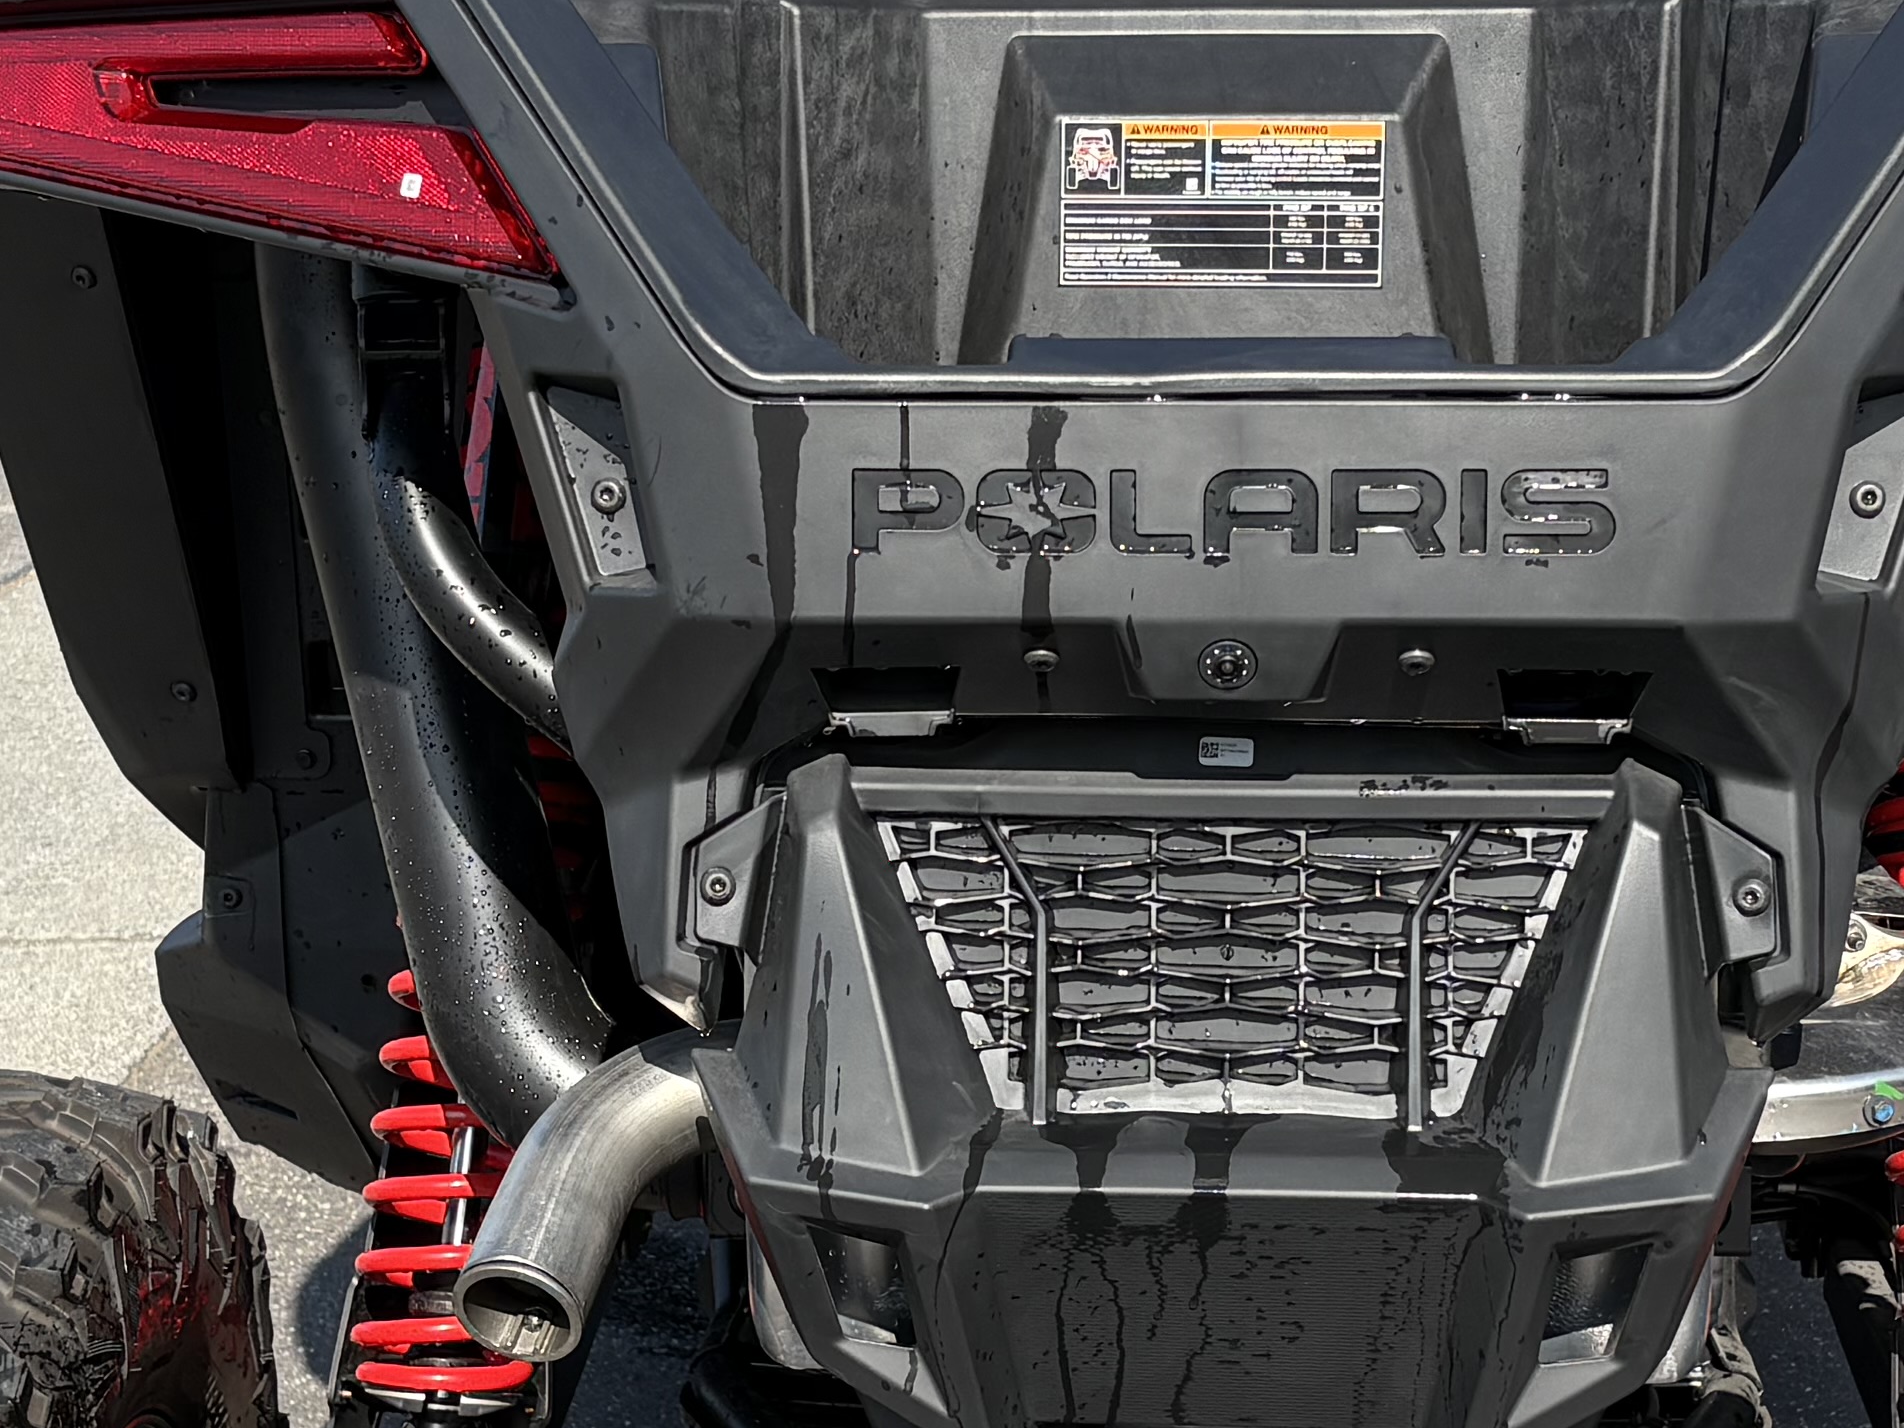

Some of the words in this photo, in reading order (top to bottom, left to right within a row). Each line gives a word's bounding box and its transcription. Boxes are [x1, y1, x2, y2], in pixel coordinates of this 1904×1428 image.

[1142, 124, 1199, 135] WARNING
[1273, 124, 1329, 135] WARNING
[851, 467, 1617, 557] POLARIS
